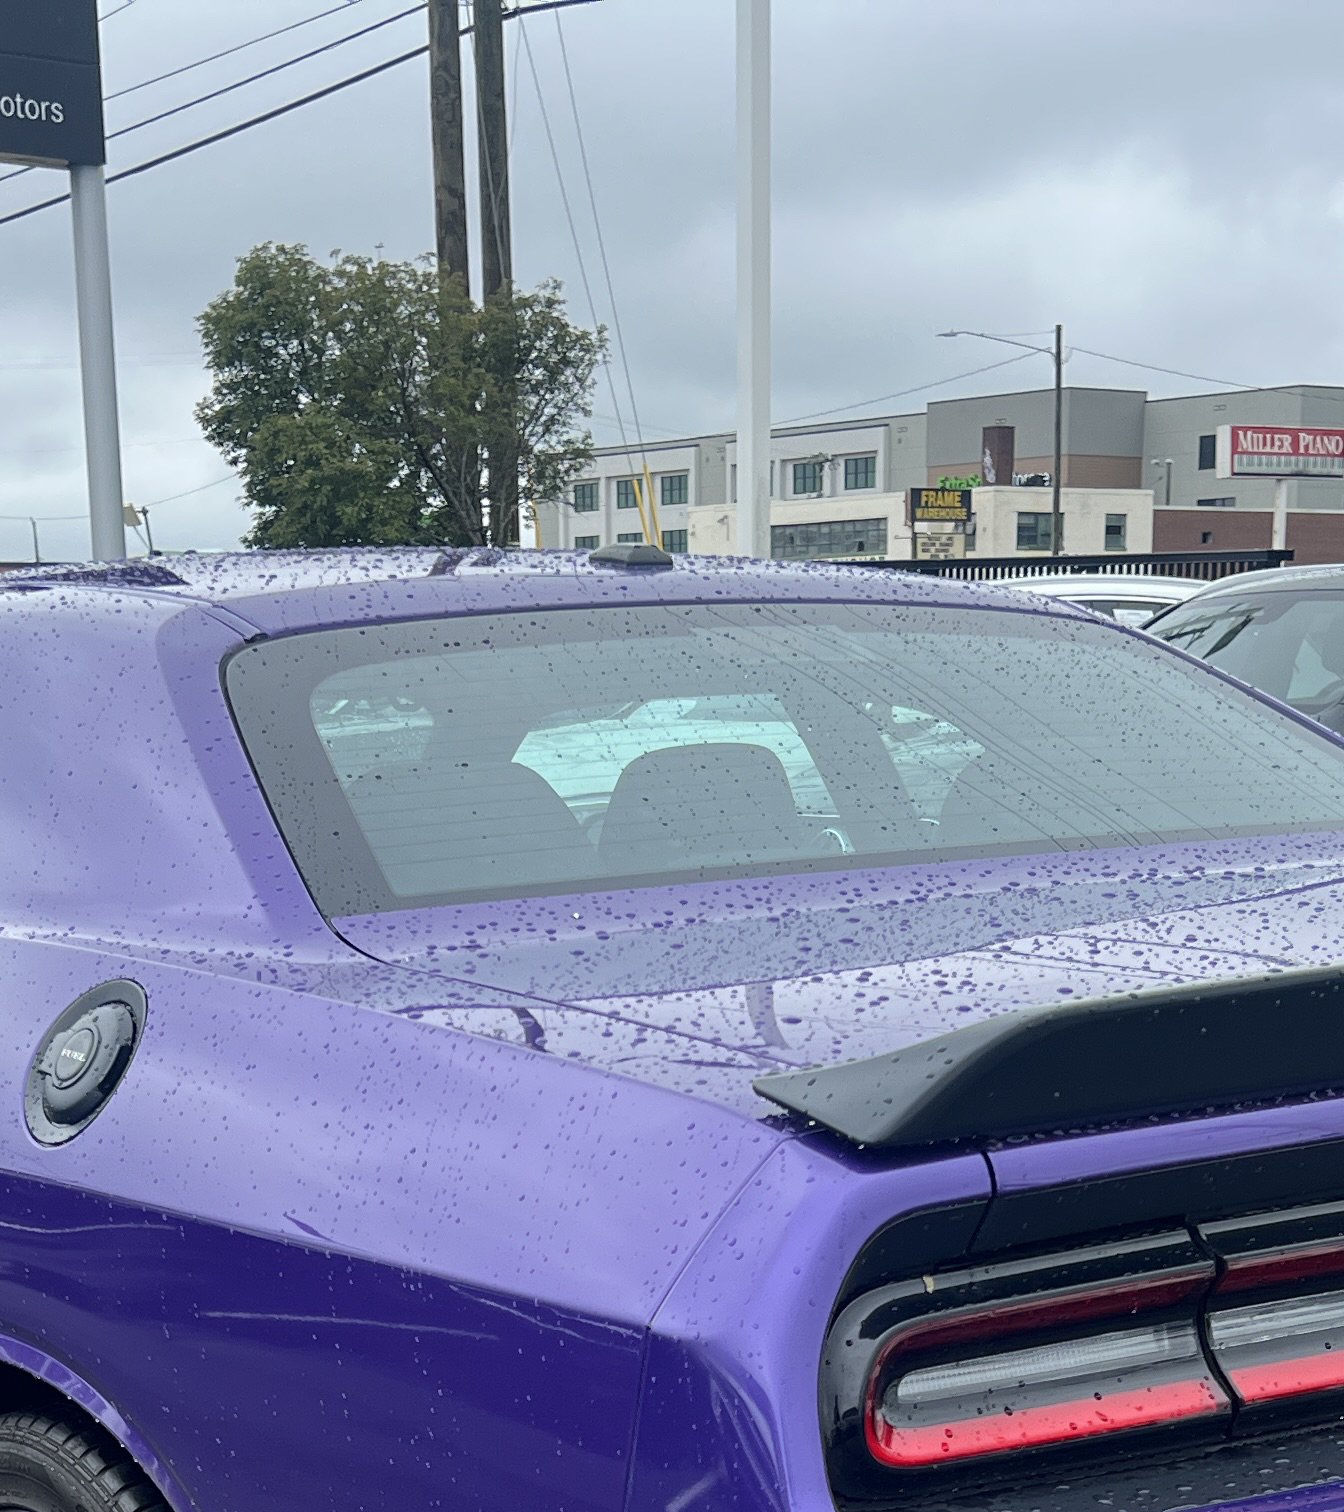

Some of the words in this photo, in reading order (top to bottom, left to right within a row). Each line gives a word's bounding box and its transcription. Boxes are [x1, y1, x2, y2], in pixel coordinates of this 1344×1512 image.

[1237, 430, 1292, 453] MILLER
[1299, 432, 1344, 455] PIANO
[920, 490, 962, 507] FRAME
[915, 508, 967, 520] WAREHOUSE
[62, 1049, 86, 1062] FUEL
